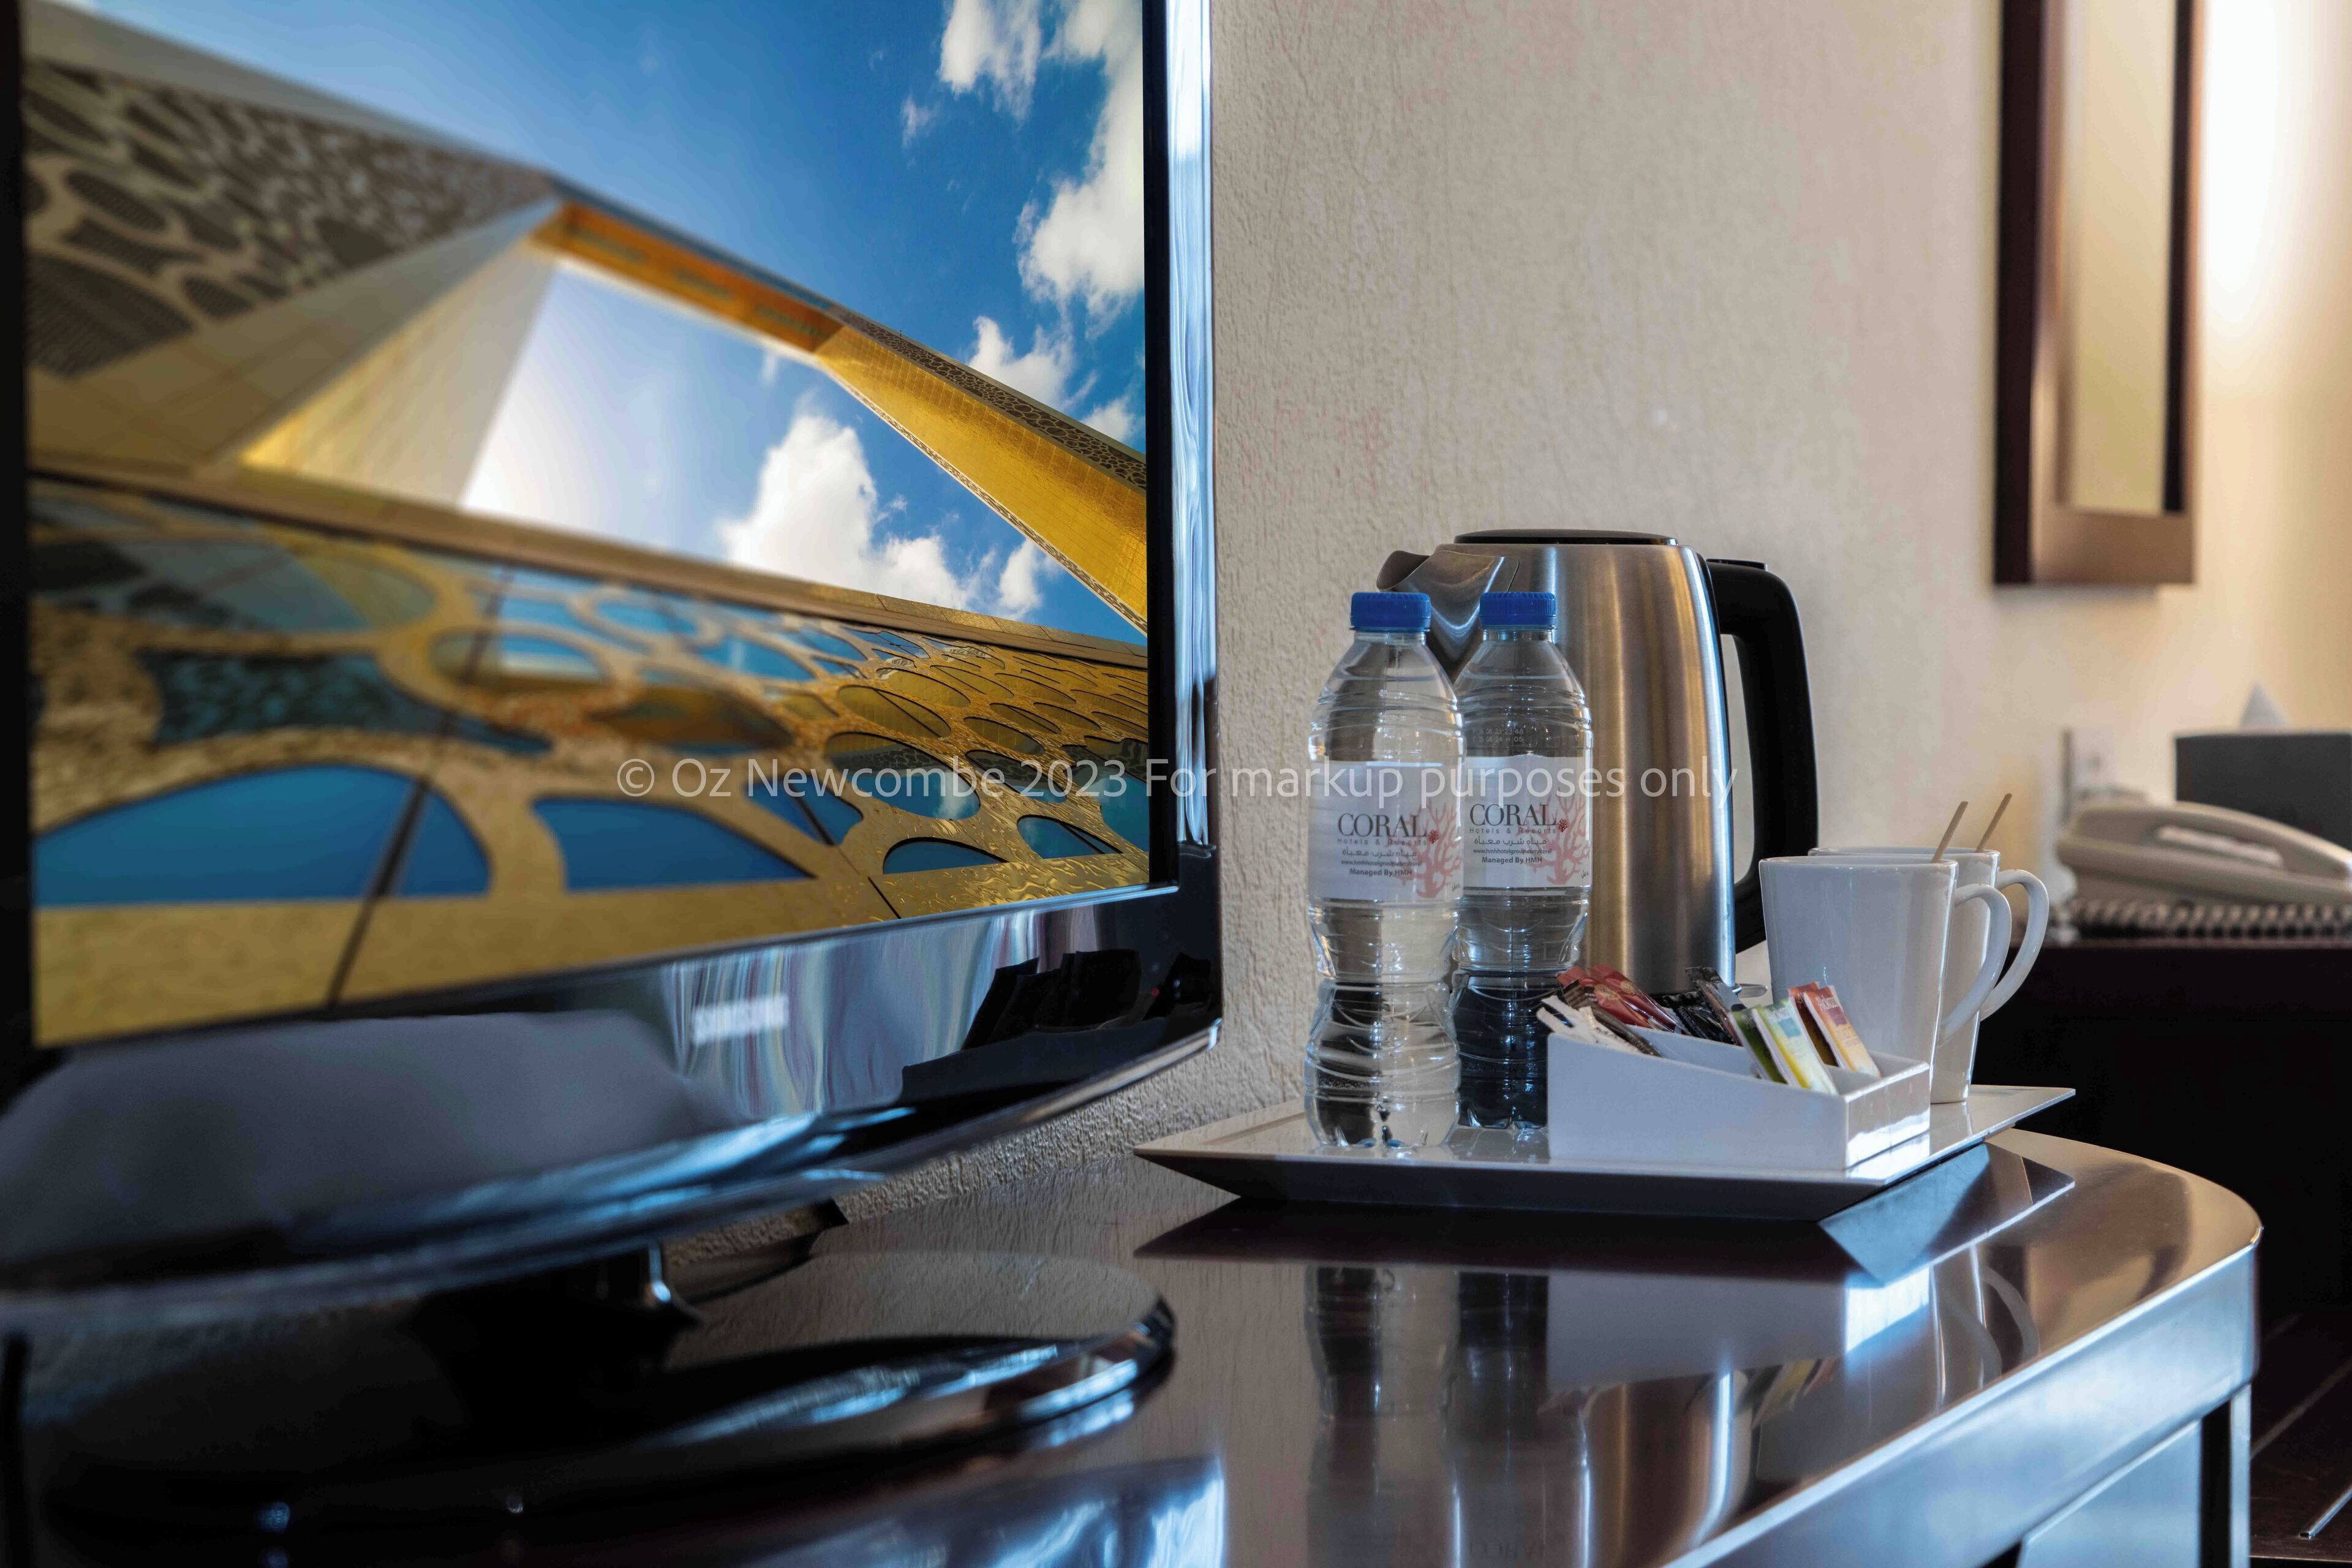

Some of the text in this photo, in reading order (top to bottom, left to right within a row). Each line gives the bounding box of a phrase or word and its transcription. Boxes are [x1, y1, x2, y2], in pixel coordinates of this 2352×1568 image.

[1470, 804, 1557, 826] CORAL
[1338, 813, 1427, 838] CORAL
[1482, 856, 1513, 865] Managed
[1349, 868, 1383, 877] Managed
[1384, 869, 1393, 878] By
